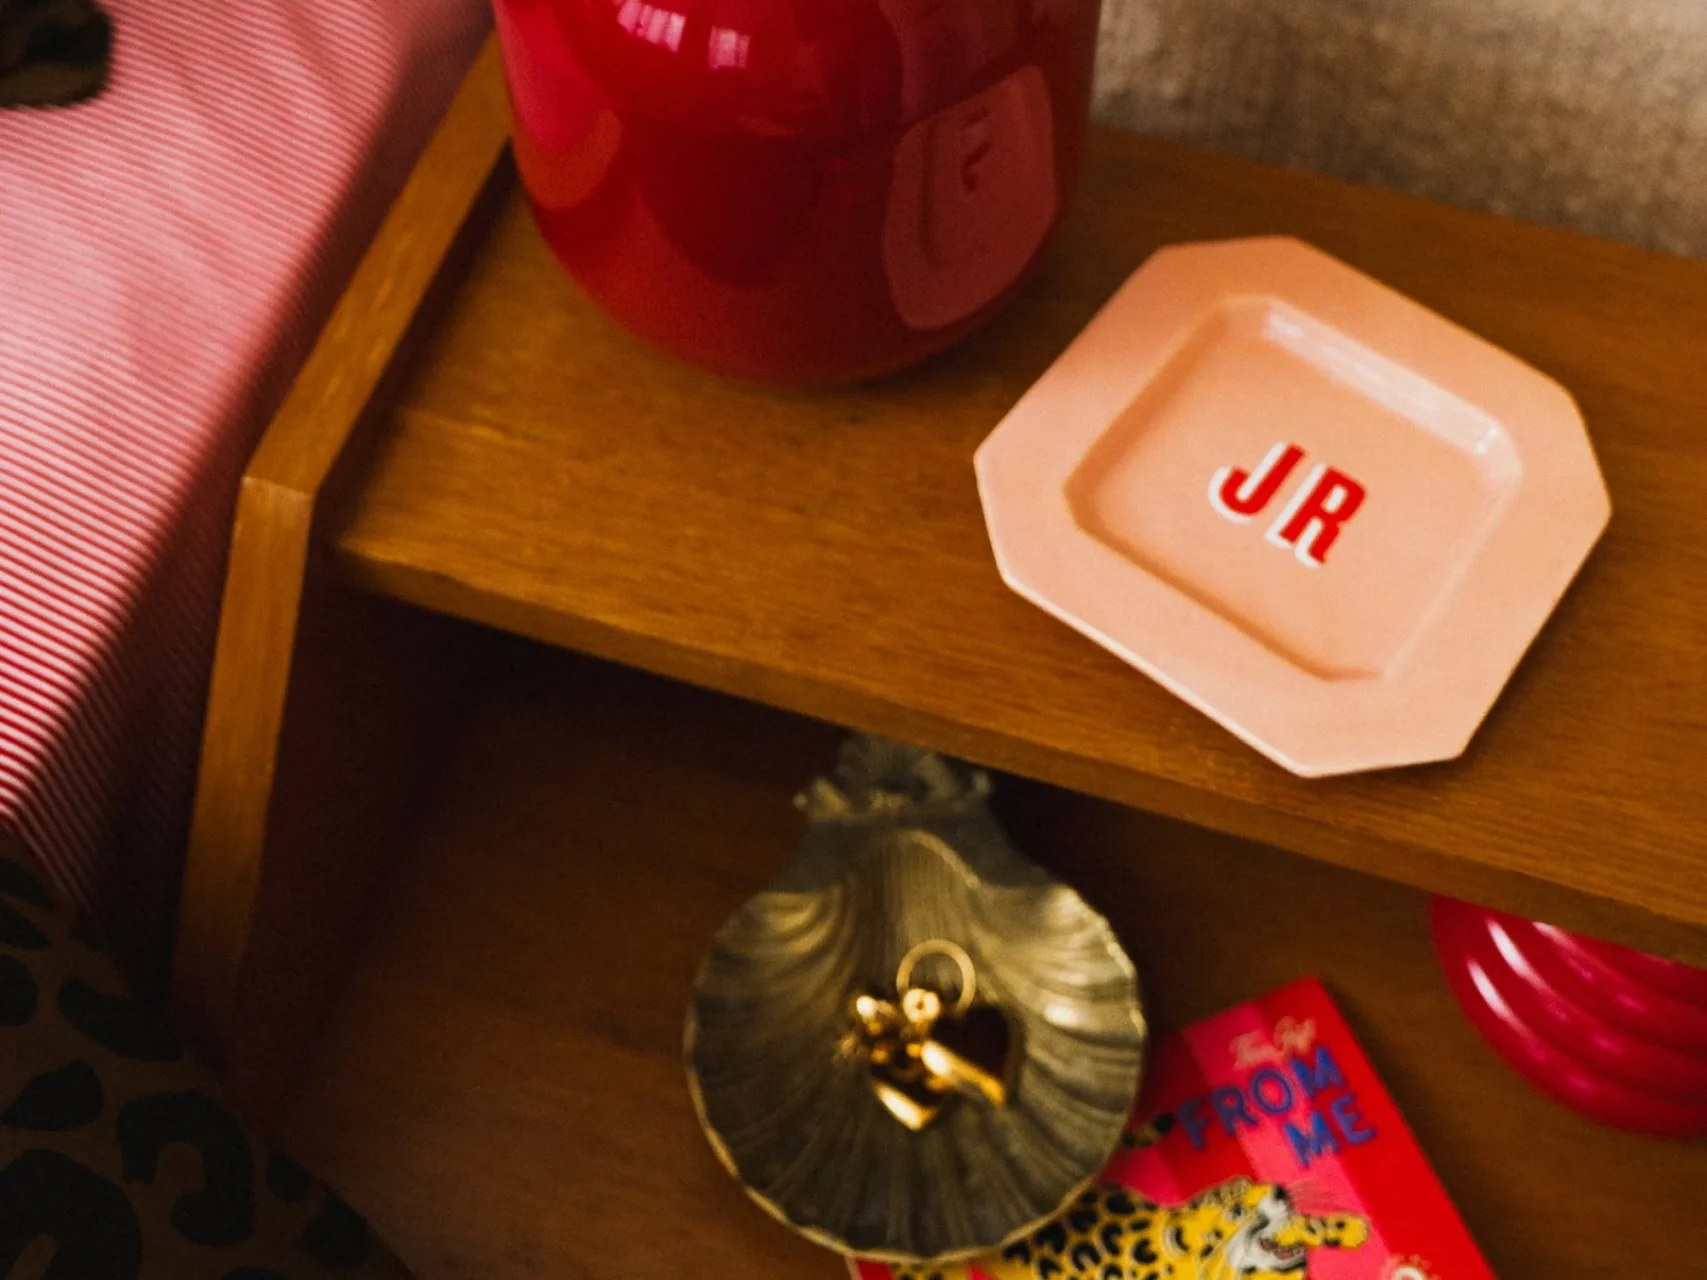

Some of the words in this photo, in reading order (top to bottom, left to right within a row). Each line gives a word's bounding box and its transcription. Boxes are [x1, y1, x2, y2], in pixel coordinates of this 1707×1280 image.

[1208, 441, 1367, 568] JR
[1176, 1046, 1344, 1149] FROM
[1284, 1095, 1377, 1168] ME
